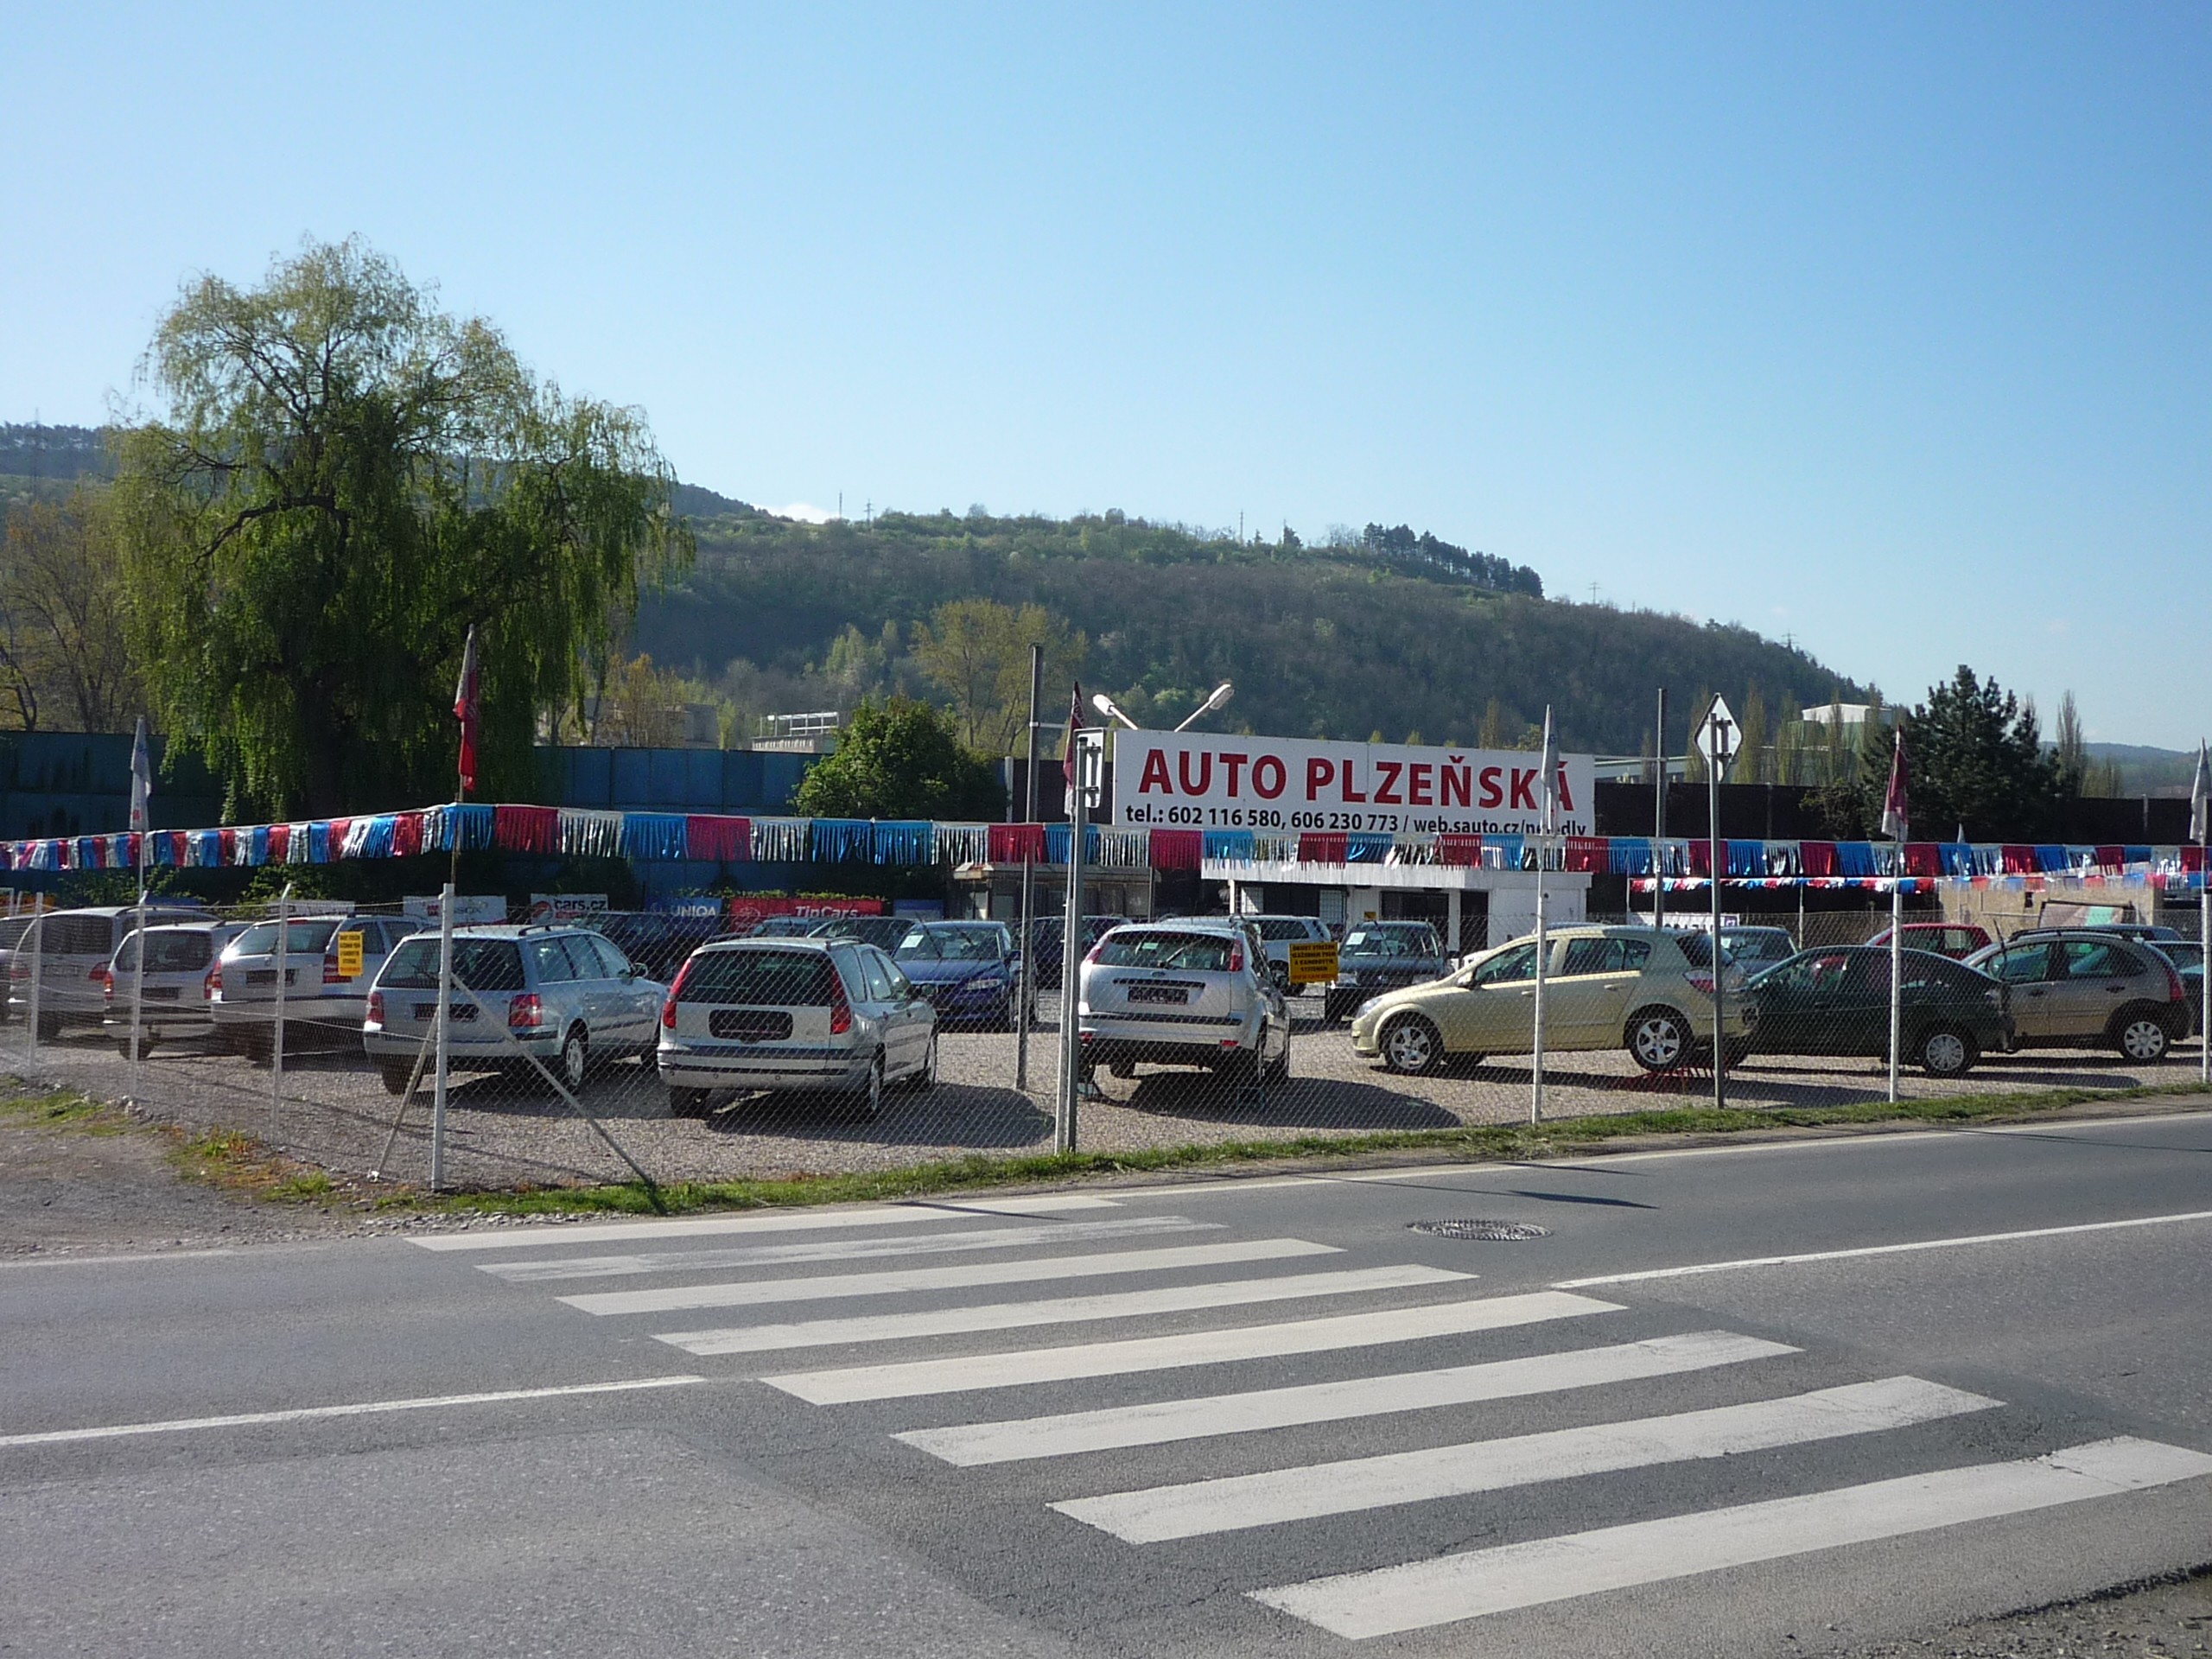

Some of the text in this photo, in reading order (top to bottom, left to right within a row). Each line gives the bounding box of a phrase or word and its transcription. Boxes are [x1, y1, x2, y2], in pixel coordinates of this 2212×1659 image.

[1138, 748, 1574, 811] AUTO PLZEŇSKÁ
[1126, 804, 1164, 823] tel.:
[1168, 806, 1203, 824] 602
[1209, 808, 1243, 826] 116
[1248, 809, 1287, 830] 580,
[1291, 811, 1325, 829] 606
[1329, 812, 1362, 830] 230
[1367, 815, 1398, 832] 773
[670, 906, 716, 917] UNIQA
